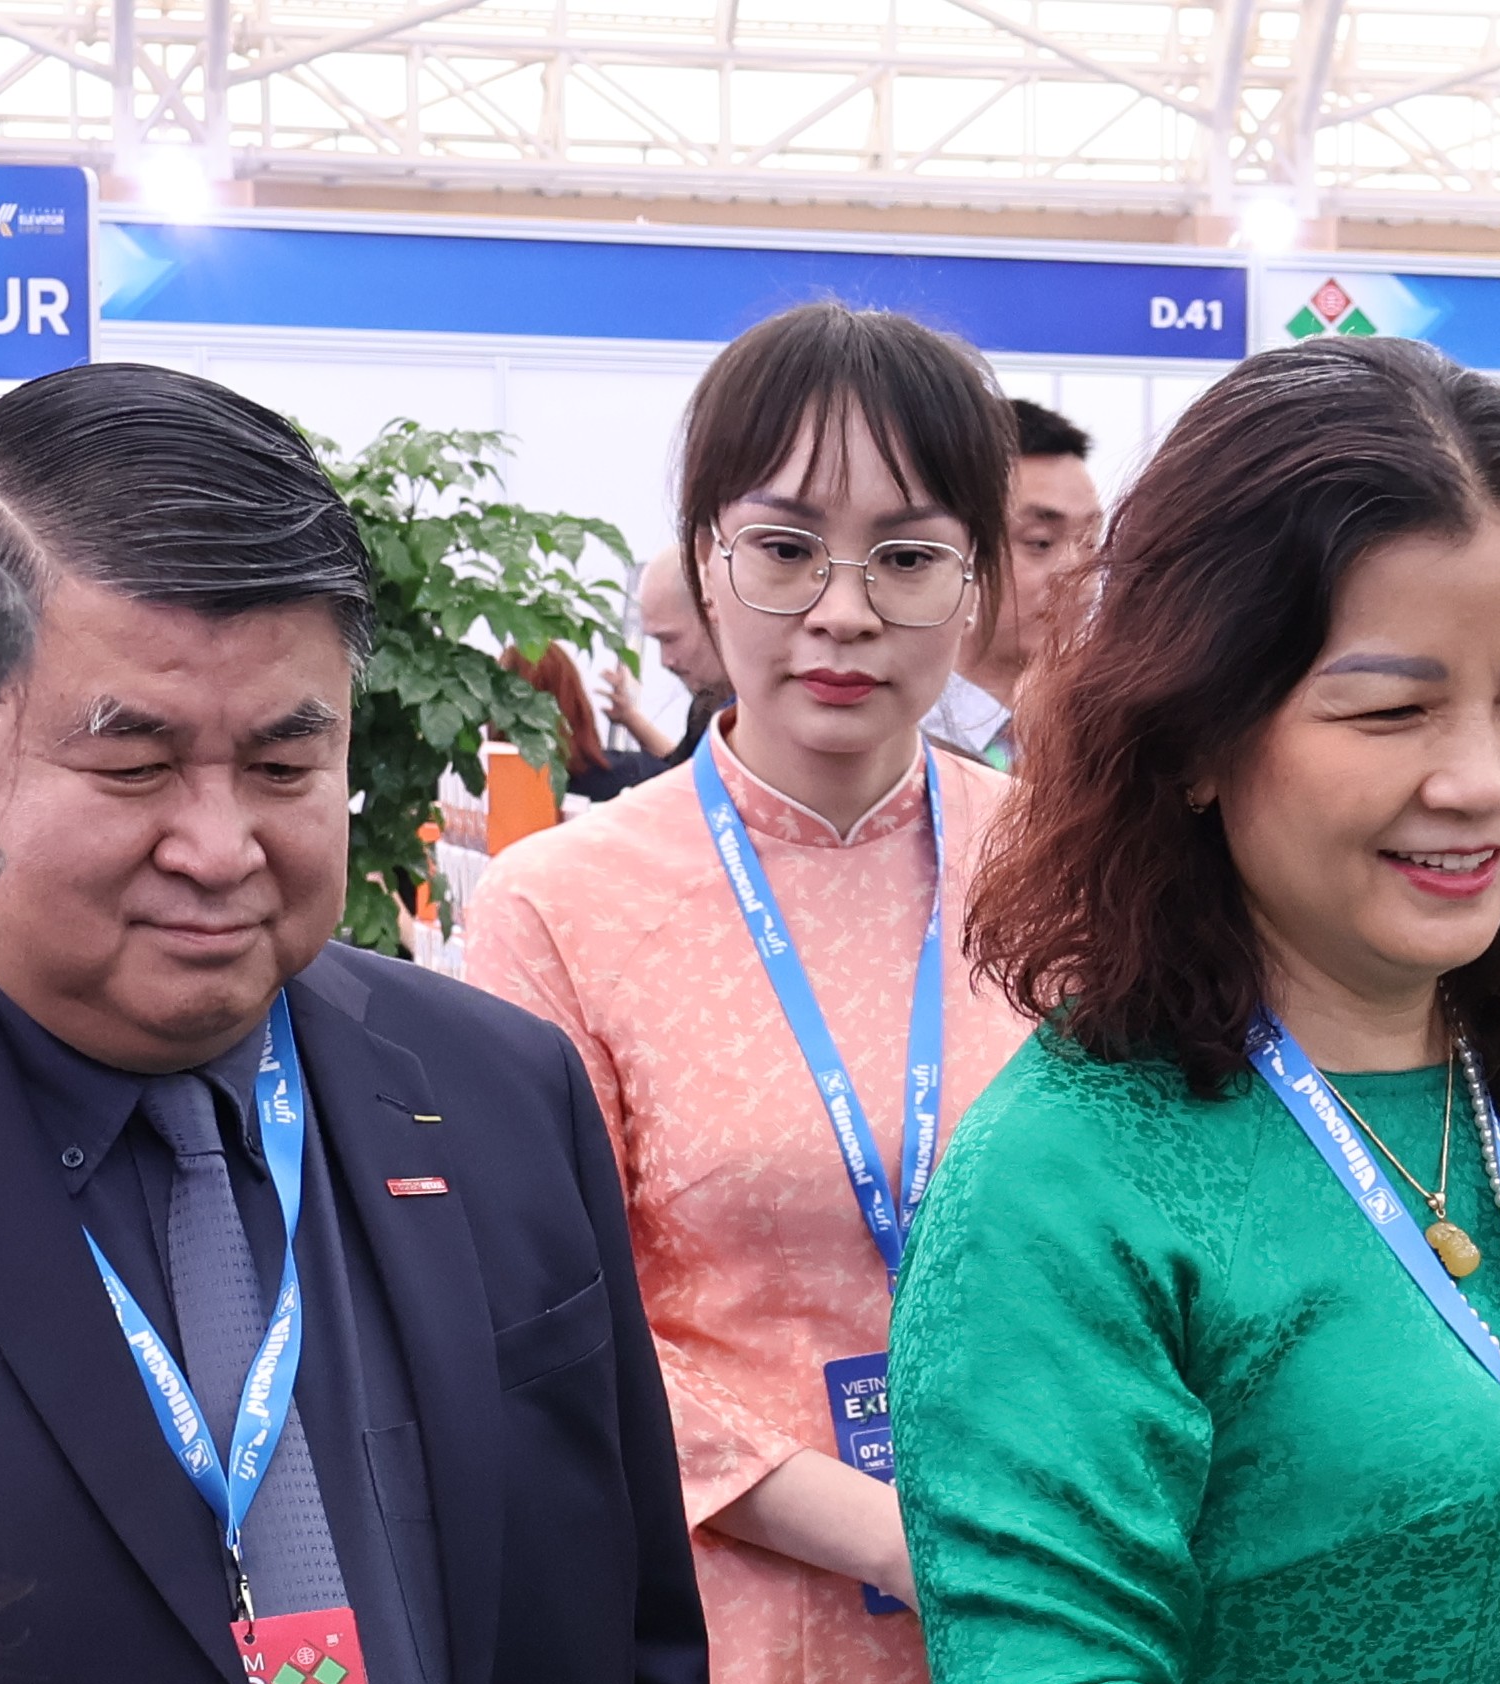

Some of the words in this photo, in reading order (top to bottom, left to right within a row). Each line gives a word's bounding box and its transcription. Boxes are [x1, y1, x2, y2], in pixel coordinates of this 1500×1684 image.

[1149, 296, 1223, 330] D.41
[1293, 1073, 1377, 1192] vinexad
[841, 1375, 887, 1396] VIETN
